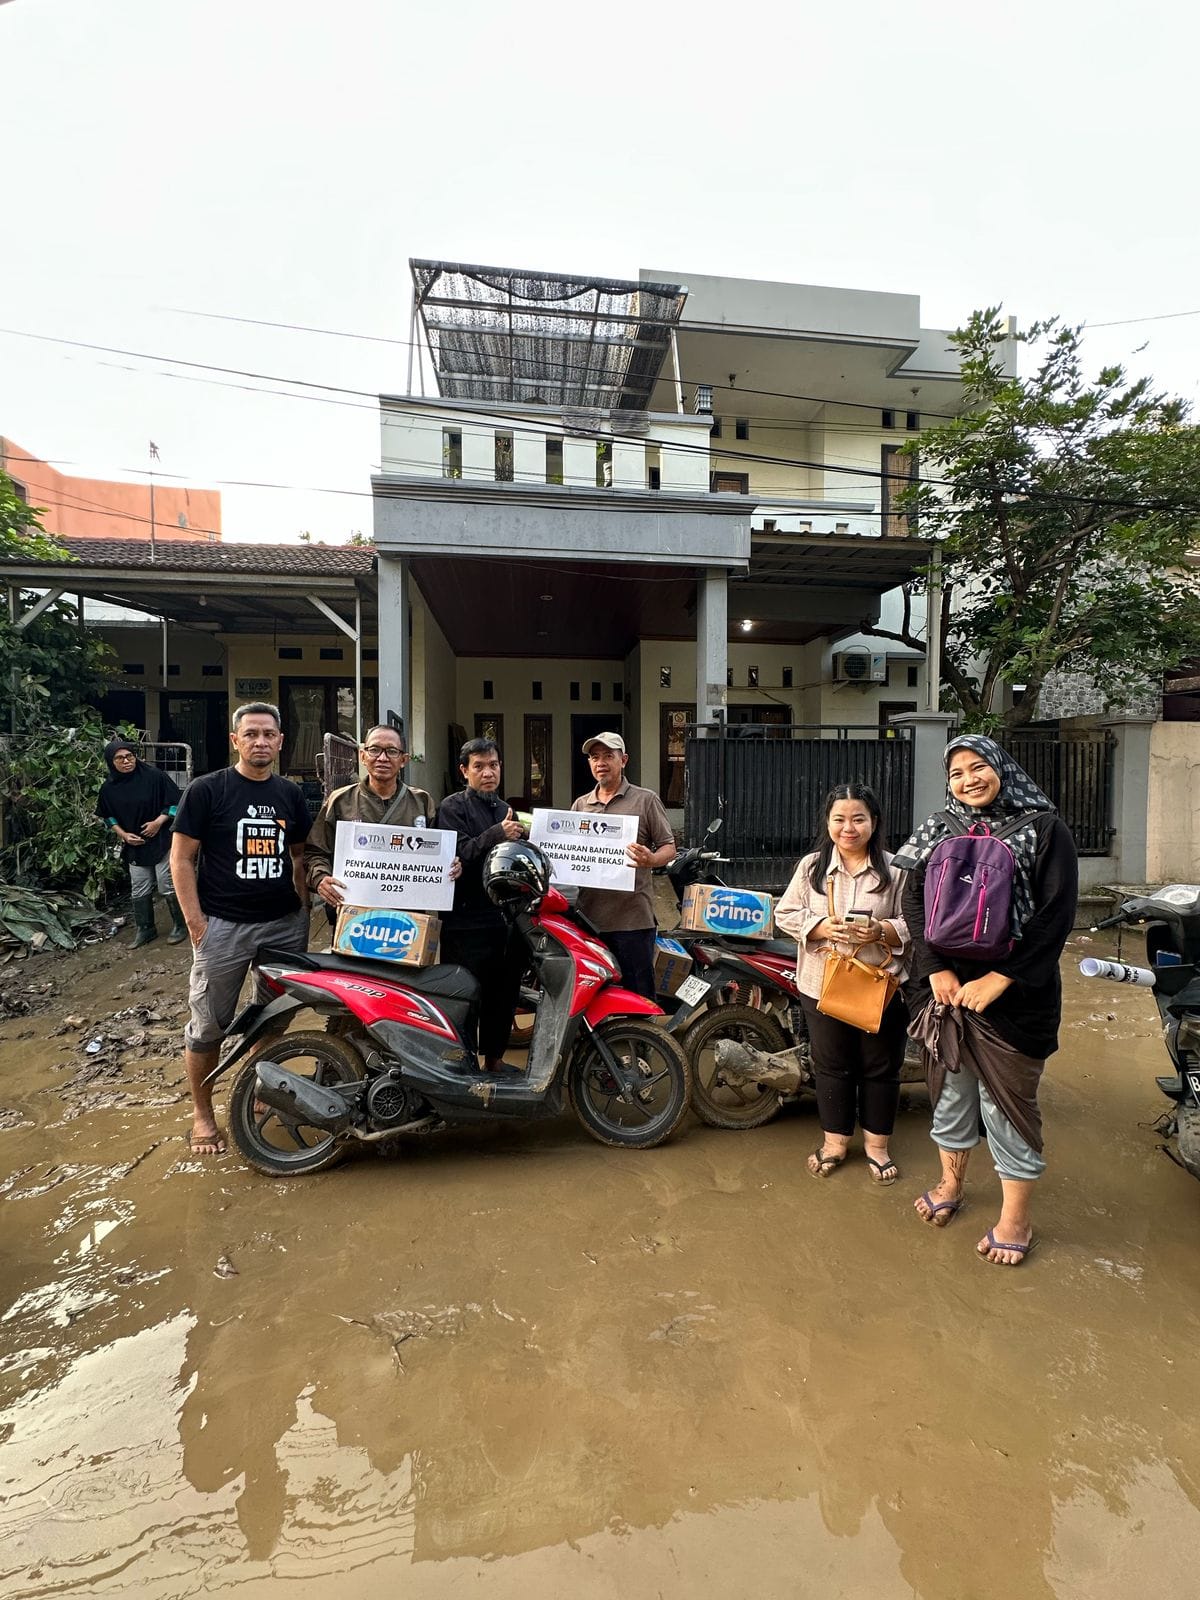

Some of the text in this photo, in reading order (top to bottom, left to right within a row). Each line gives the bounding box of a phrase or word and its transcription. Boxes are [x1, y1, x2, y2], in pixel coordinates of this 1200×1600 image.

[257, 805, 276, 815] TDA
[561, 820, 576, 828] TDA
[247, 827, 276, 837] TO THE
[368, 834, 386, 843] TDA
[247, 839, 276, 855] NEXT
[540, 842, 625, 856] PENYALURAN BANTUAN
[544, 851, 624, 866] ORBAN BANJIR BEKASI
[345, 859, 443, 873] PENYALURAN BANTUAN
[571, 864, 591, 873] 2025
[344, 870, 442, 884] KORBAN BANJIR BEKASI
[380, 884, 404, 892] 2025
[706, 901, 764, 922] prima
[349, 923, 415, 947] prima
[578, 973, 600, 981] HONDA
